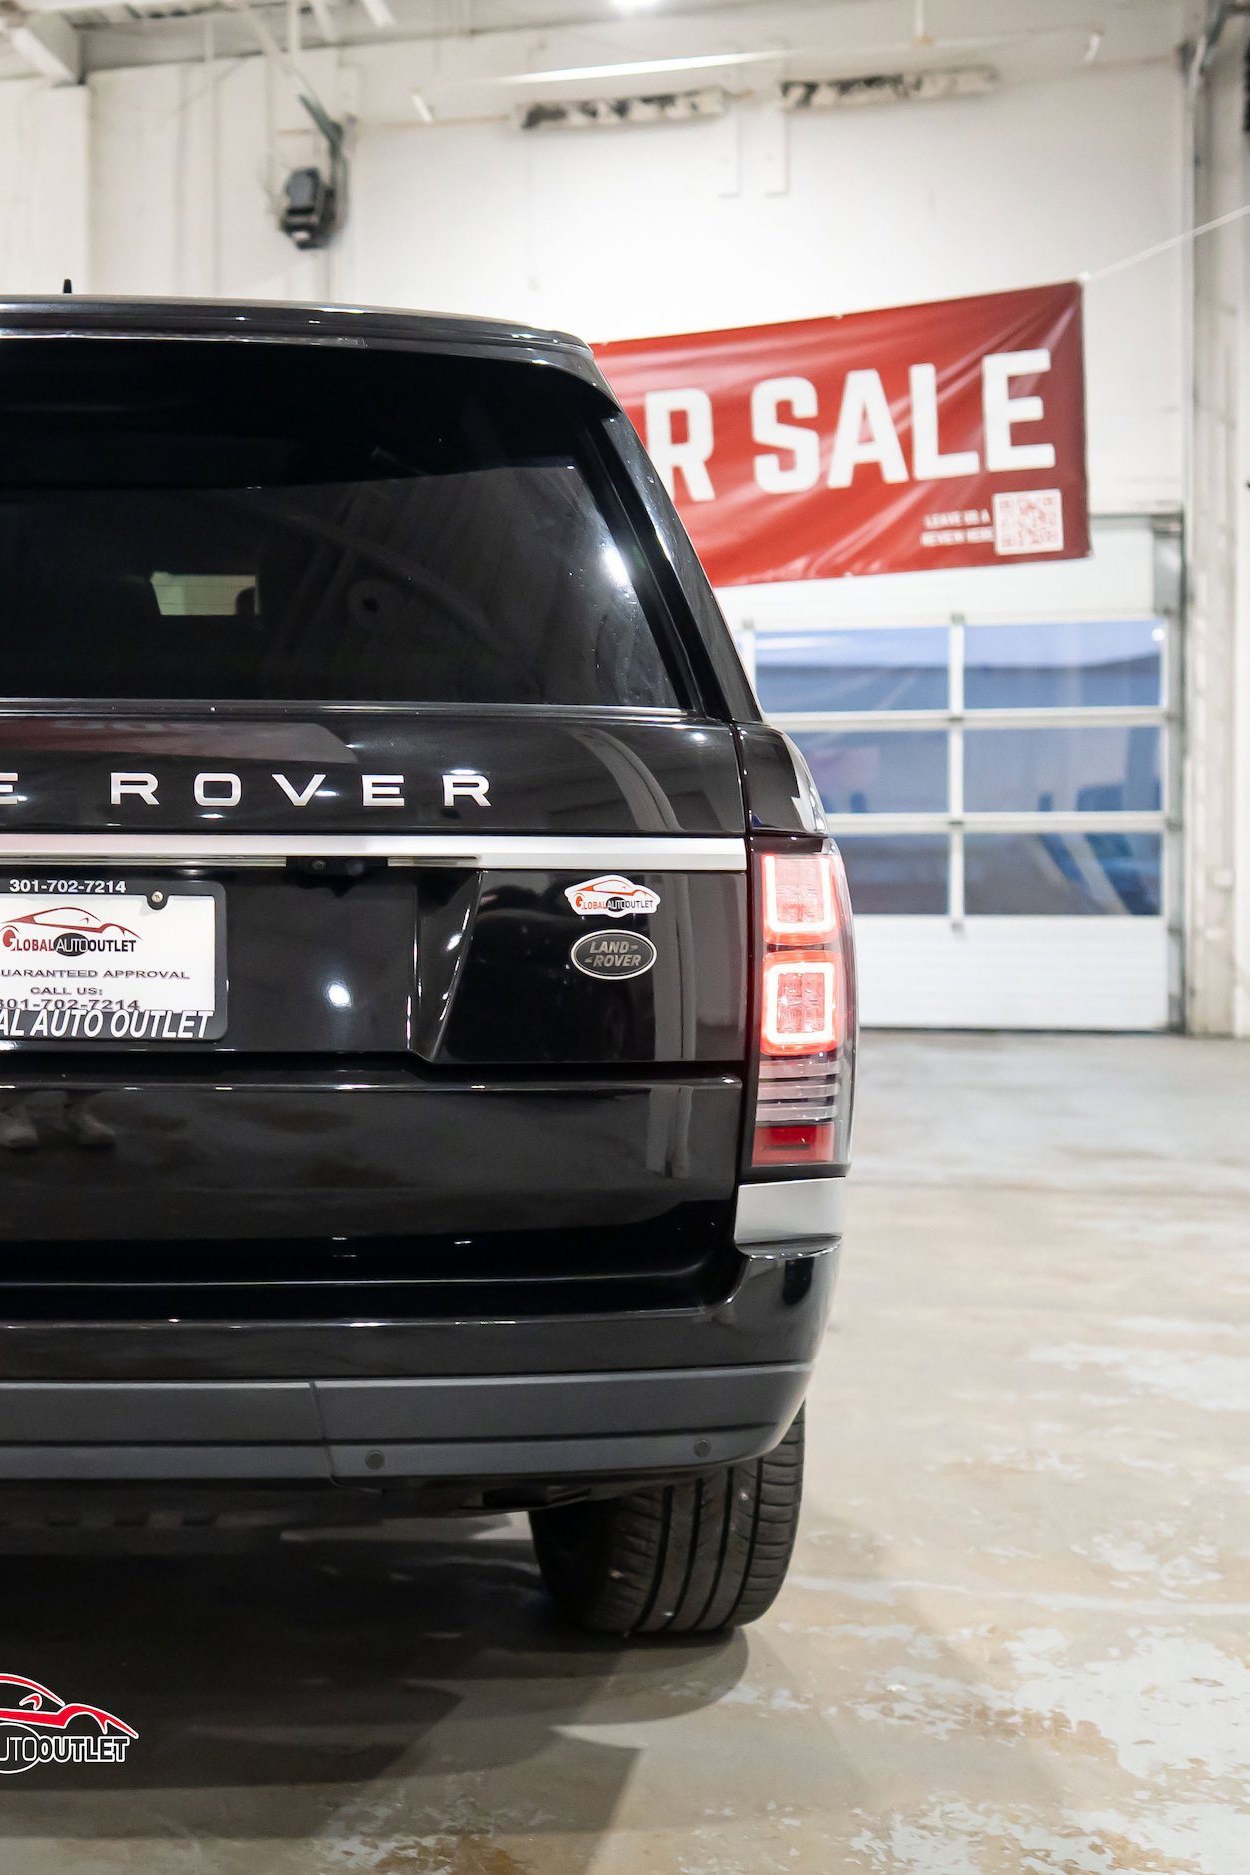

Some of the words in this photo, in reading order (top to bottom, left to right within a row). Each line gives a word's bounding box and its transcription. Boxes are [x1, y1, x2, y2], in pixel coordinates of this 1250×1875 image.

[751, 348, 1056, 495] SALE
[110, 772, 491, 807] ROVER
[9, 879, 126, 893] 301-702-7214
[590, 941, 630, 954] LAND
[593, 955, 641, 967] ROVER
[103, 970, 190, 979] APPROVAL
[30, 987, 71, 995] CALL
[77, 987, 103, 996] US:
[29, 1008, 104, 1038] AUTO
[110, 1009, 214, 1039] OUTLET
